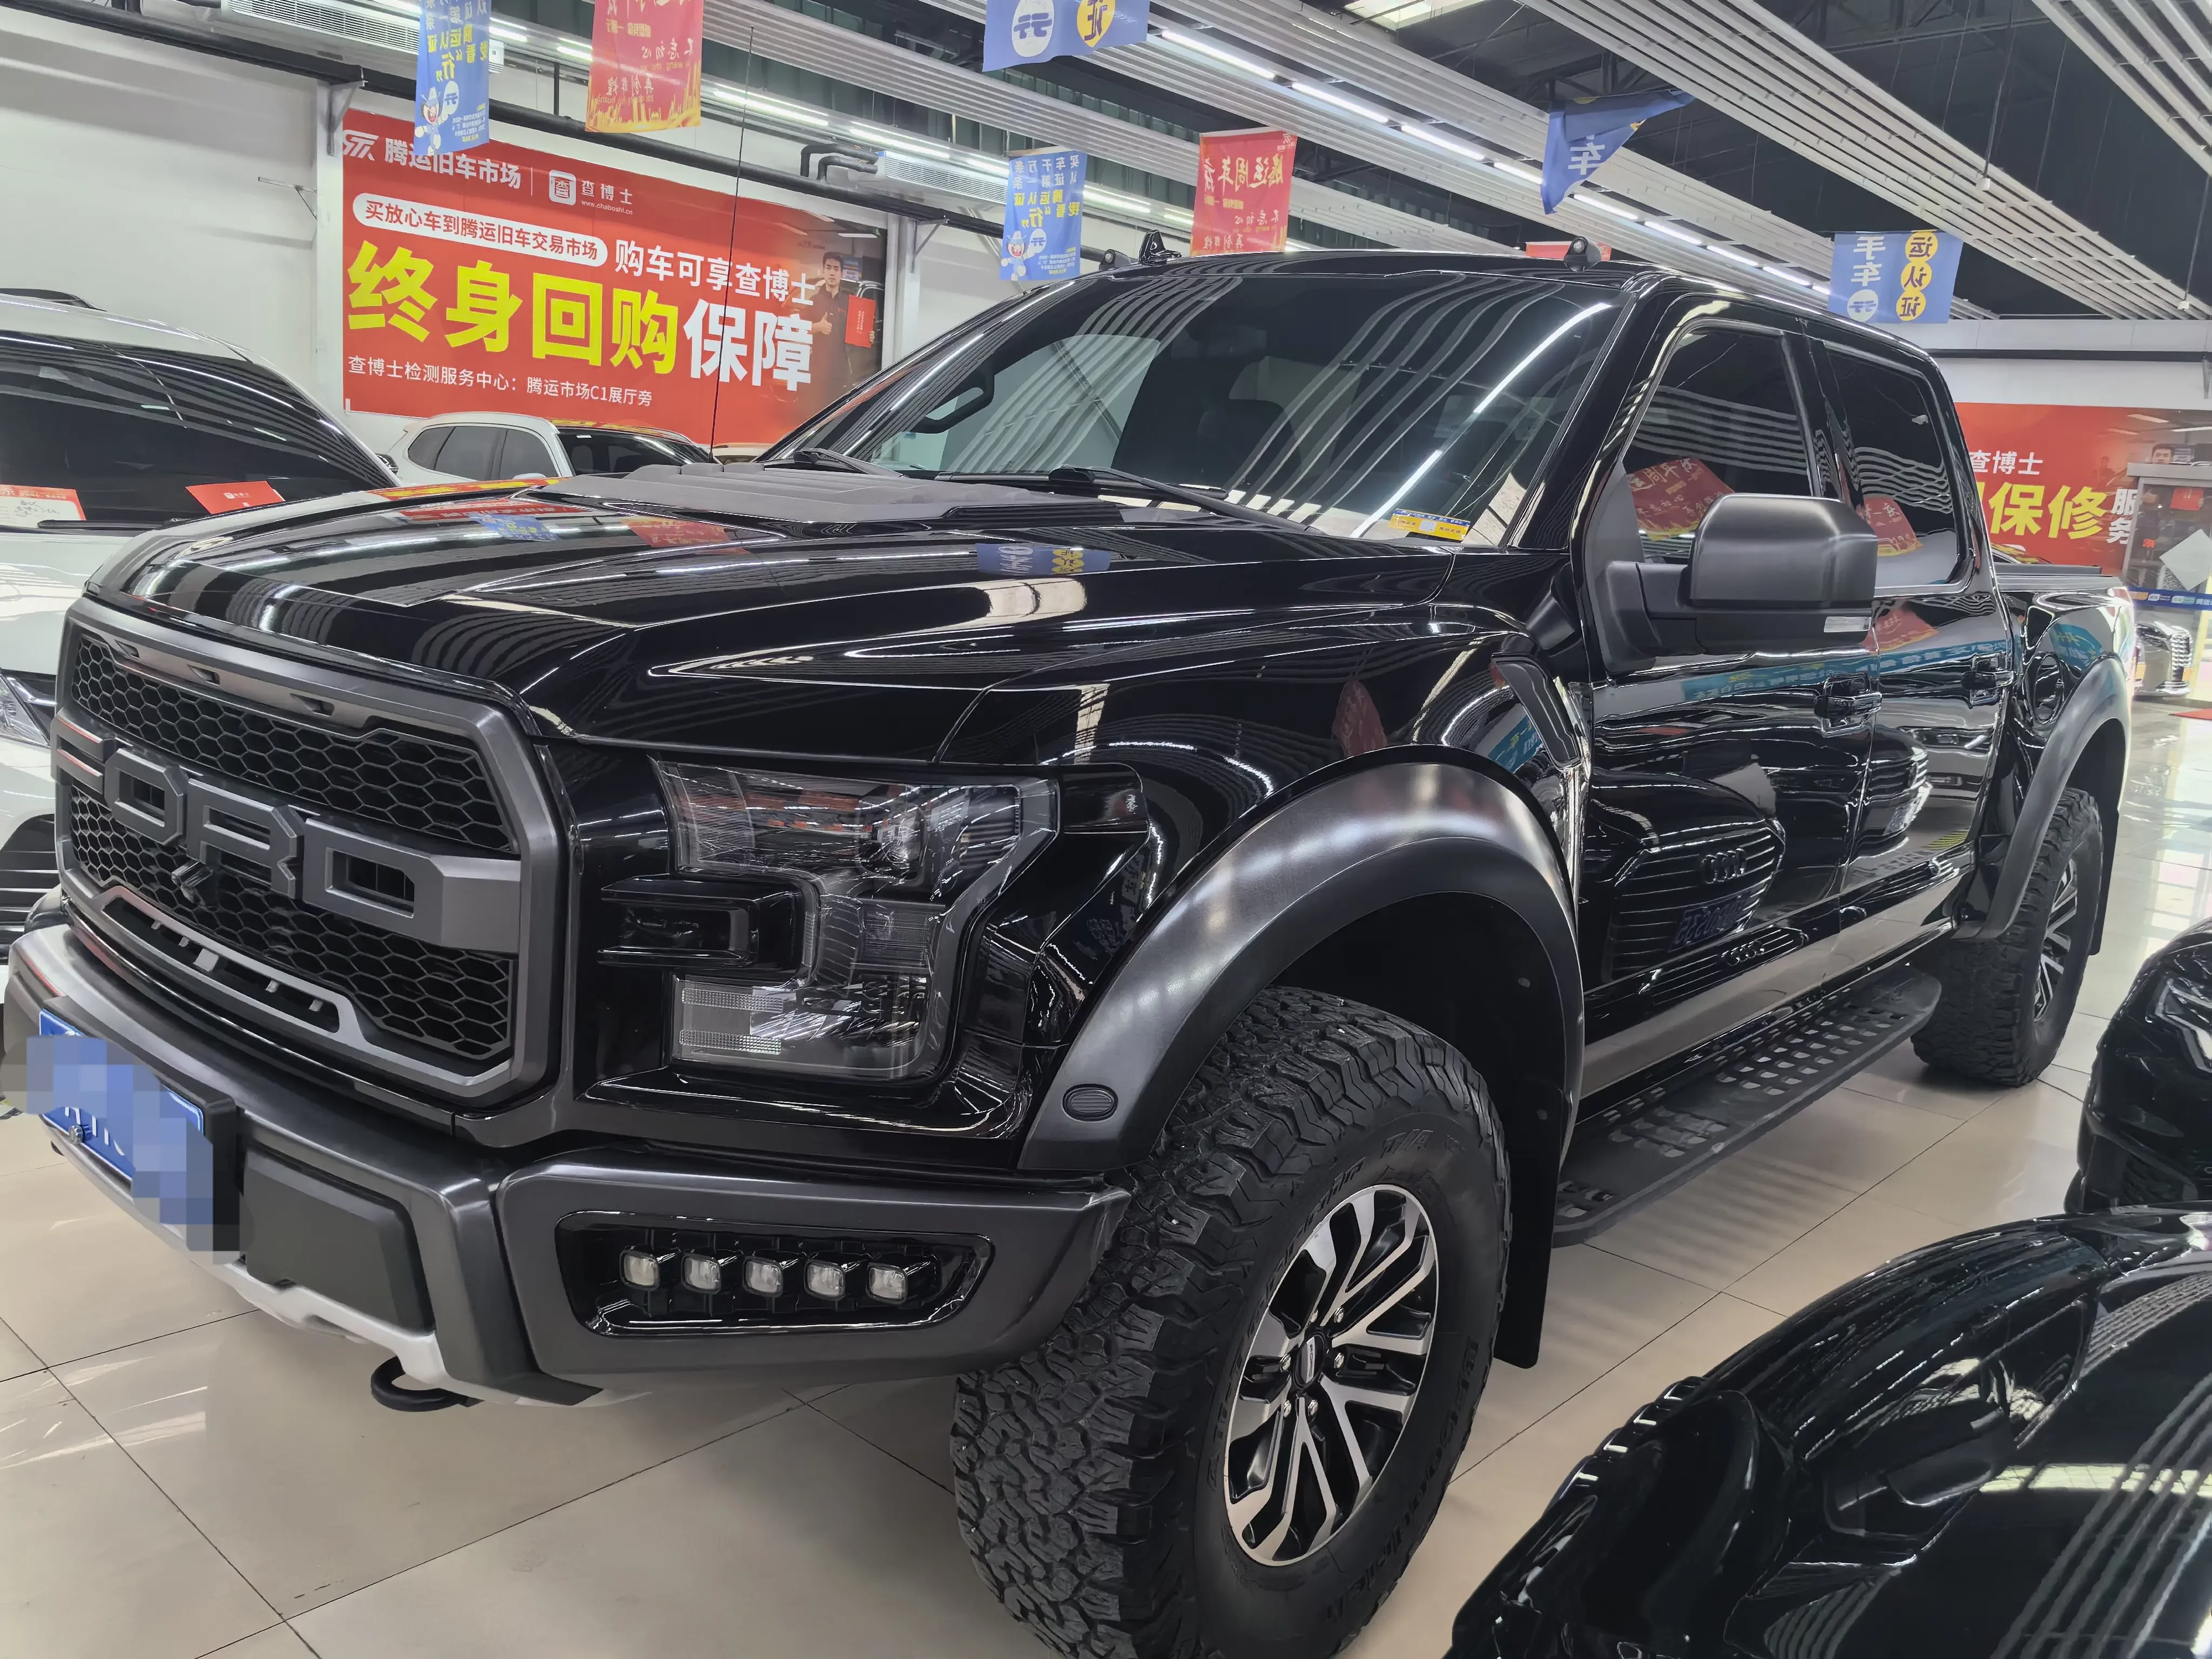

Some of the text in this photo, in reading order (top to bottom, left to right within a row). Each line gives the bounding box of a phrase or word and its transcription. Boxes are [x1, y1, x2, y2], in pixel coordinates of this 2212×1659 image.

[385, 137, 521, 189] 腾运旧车市场
[581, 180, 633, 205] 查博士
[365, 199, 815, 306] 买放心车到腾运旧车交易市场 购车可享查博士
[347, 240, 813, 392] 终身回购保障
[1968, 449, 2044, 475] 查博士
[1976, 481, 2107, 539] 保修
[51, 714, 444, 946] FORD
